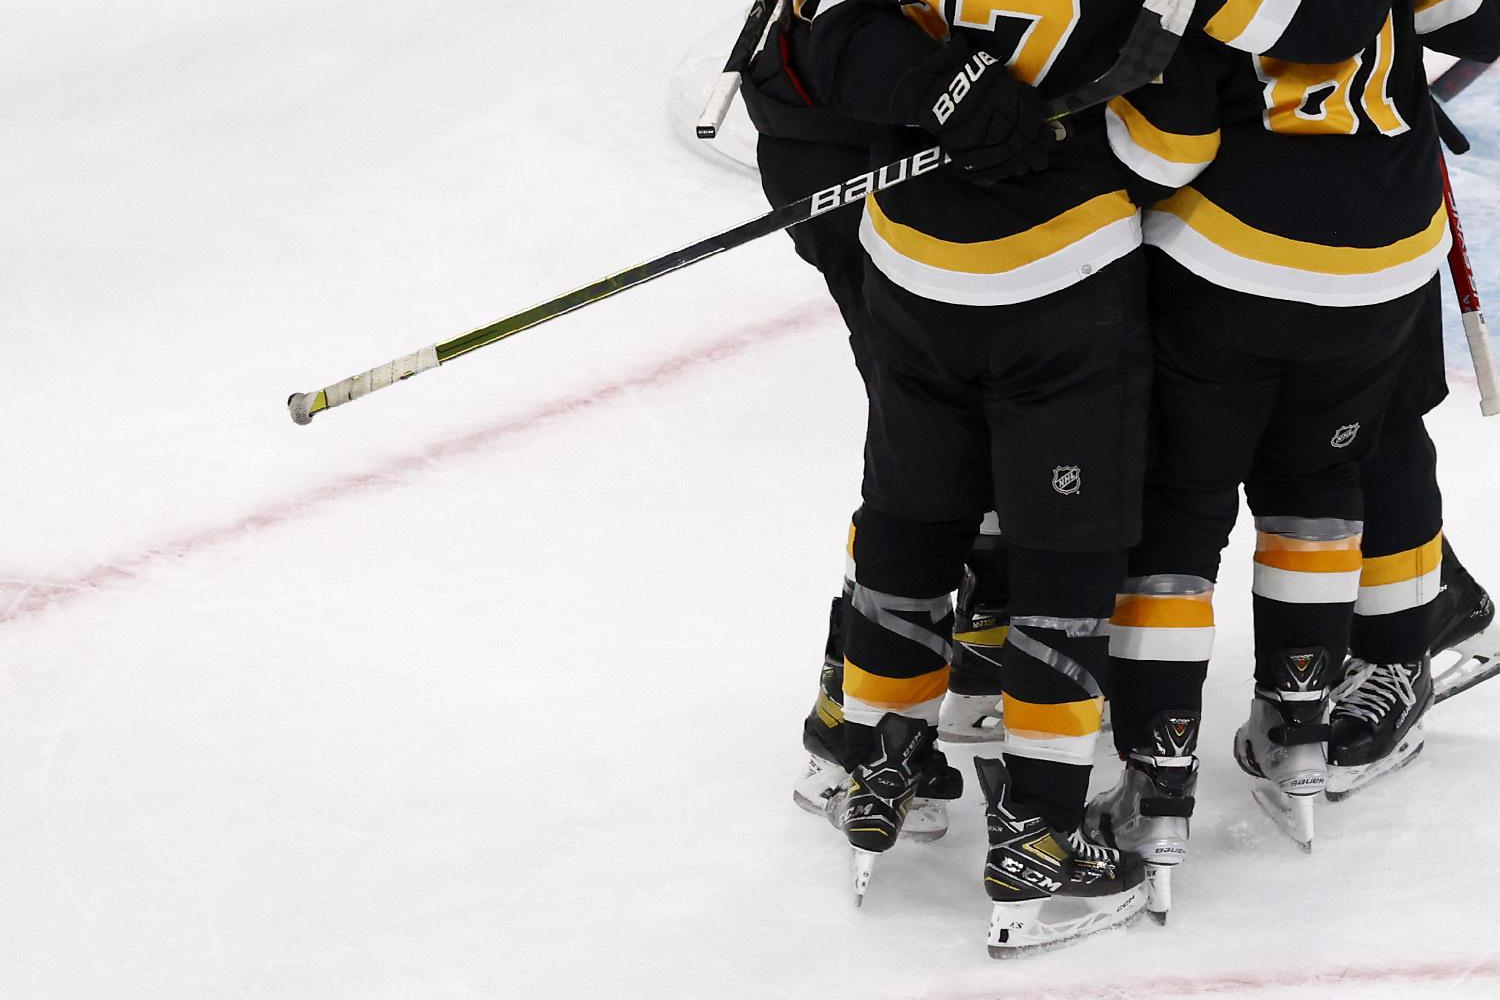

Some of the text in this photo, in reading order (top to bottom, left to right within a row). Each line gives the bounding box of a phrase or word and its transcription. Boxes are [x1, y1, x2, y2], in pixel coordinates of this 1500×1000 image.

[932, 50, 998, 126] BAUE
[810, 146, 952, 216] BAUE
[1056, 468, 1079, 489] NHL
[1001, 855, 1064, 893] CCM
